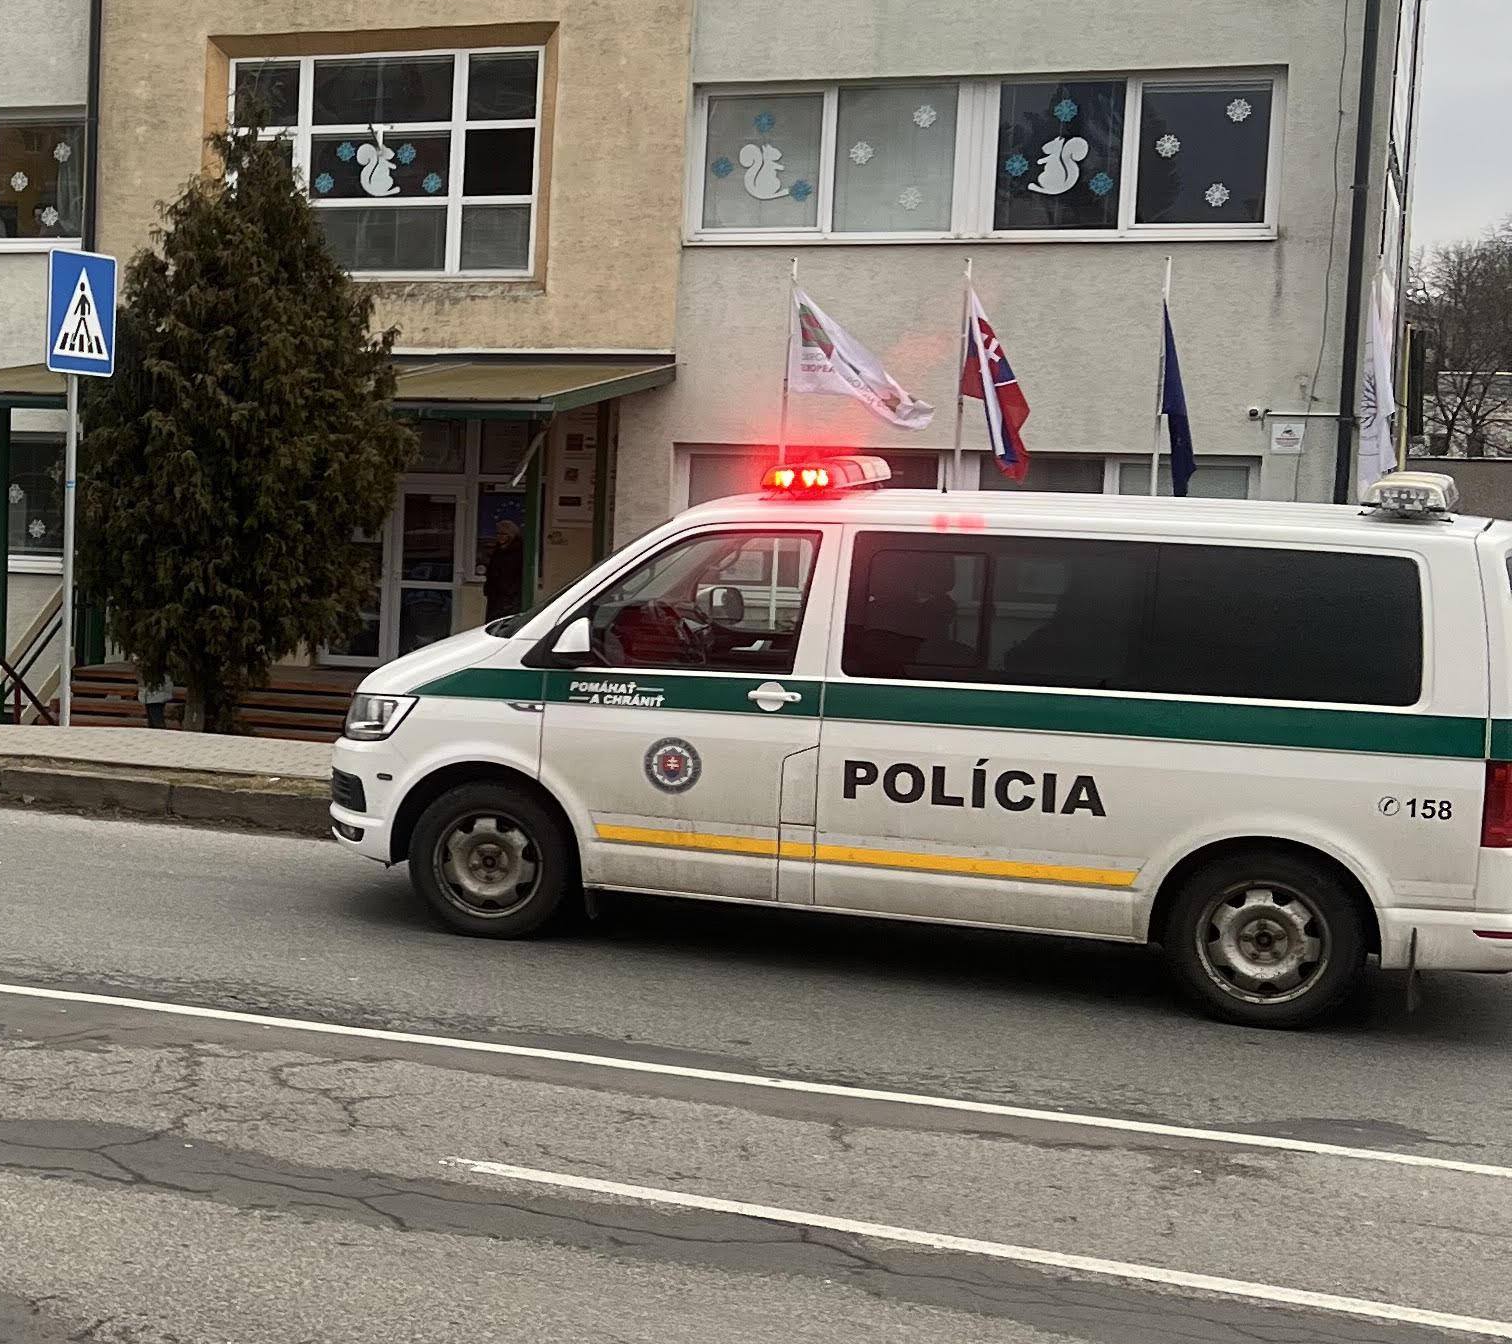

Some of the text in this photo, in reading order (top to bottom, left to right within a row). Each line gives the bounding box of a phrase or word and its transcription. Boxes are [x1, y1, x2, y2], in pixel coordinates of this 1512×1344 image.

[569, 680, 637, 694] POMÁHAŤ
[589, 693, 665, 707] A CHRÁNIŤ
[843, 758, 1106, 817] POLÍCIA
[1405, 798, 1452, 820] 158
